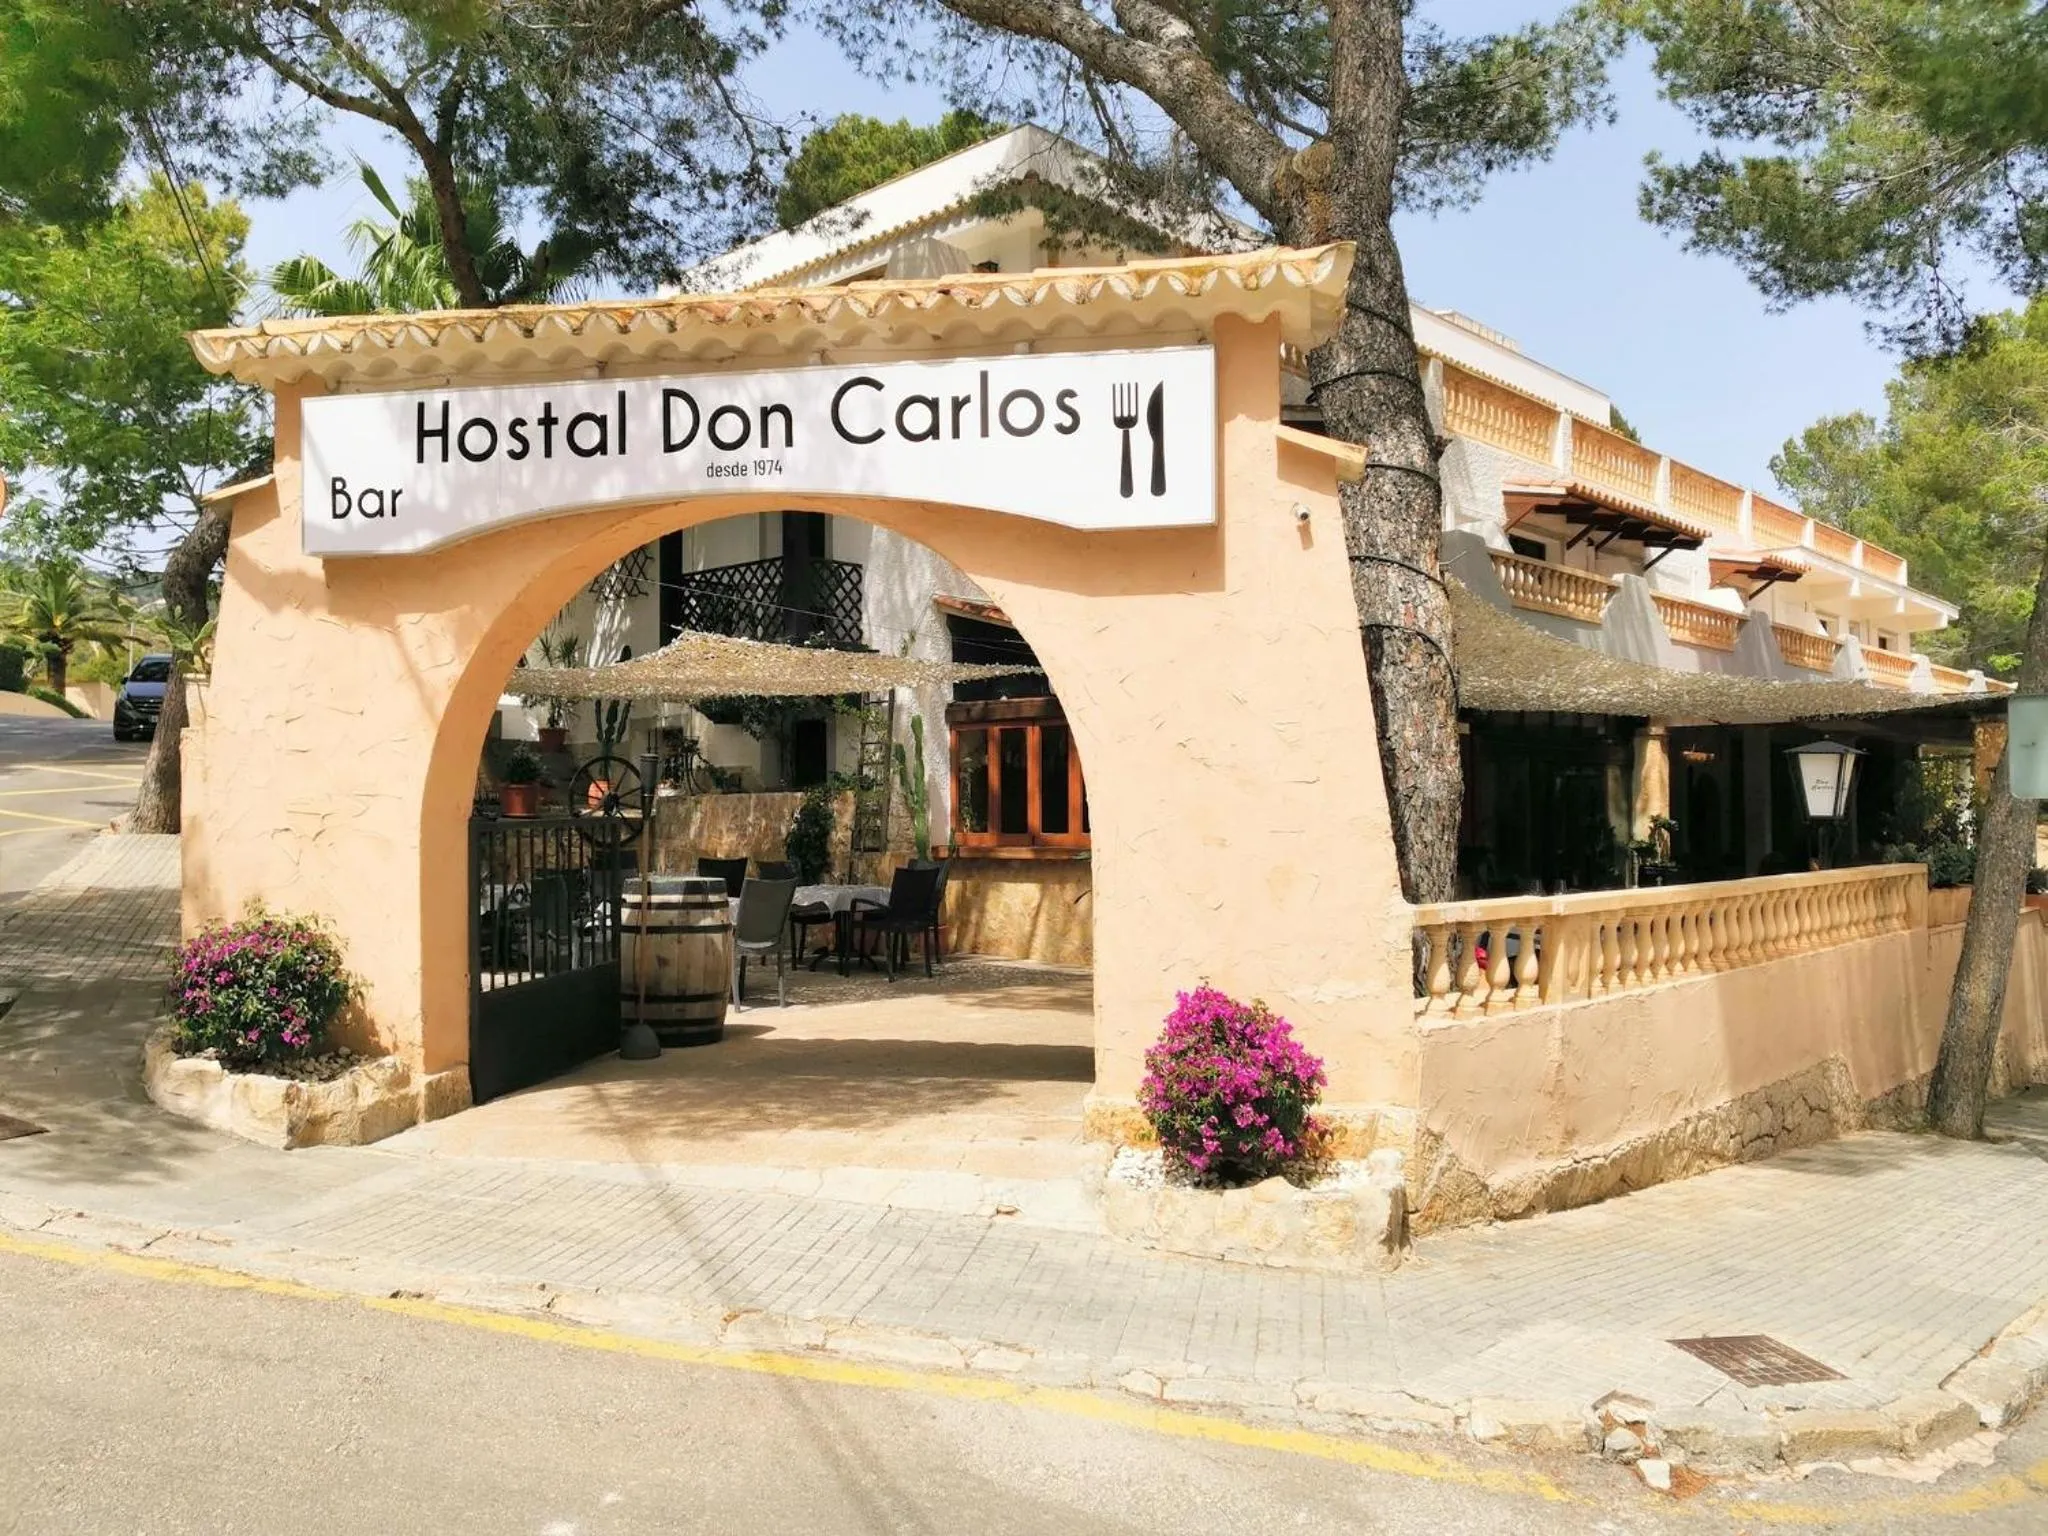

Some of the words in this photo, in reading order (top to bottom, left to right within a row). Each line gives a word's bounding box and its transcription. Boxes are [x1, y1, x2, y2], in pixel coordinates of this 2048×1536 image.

[416, 390, 627, 464] Hostal
[662, 388, 794, 455] Don
[830, 370, 1081, 445] Carlos
[706, 462, 748, 478] desde
[753, 459, 783, 477] 1974
[331, 476, 403, 520] Bar
